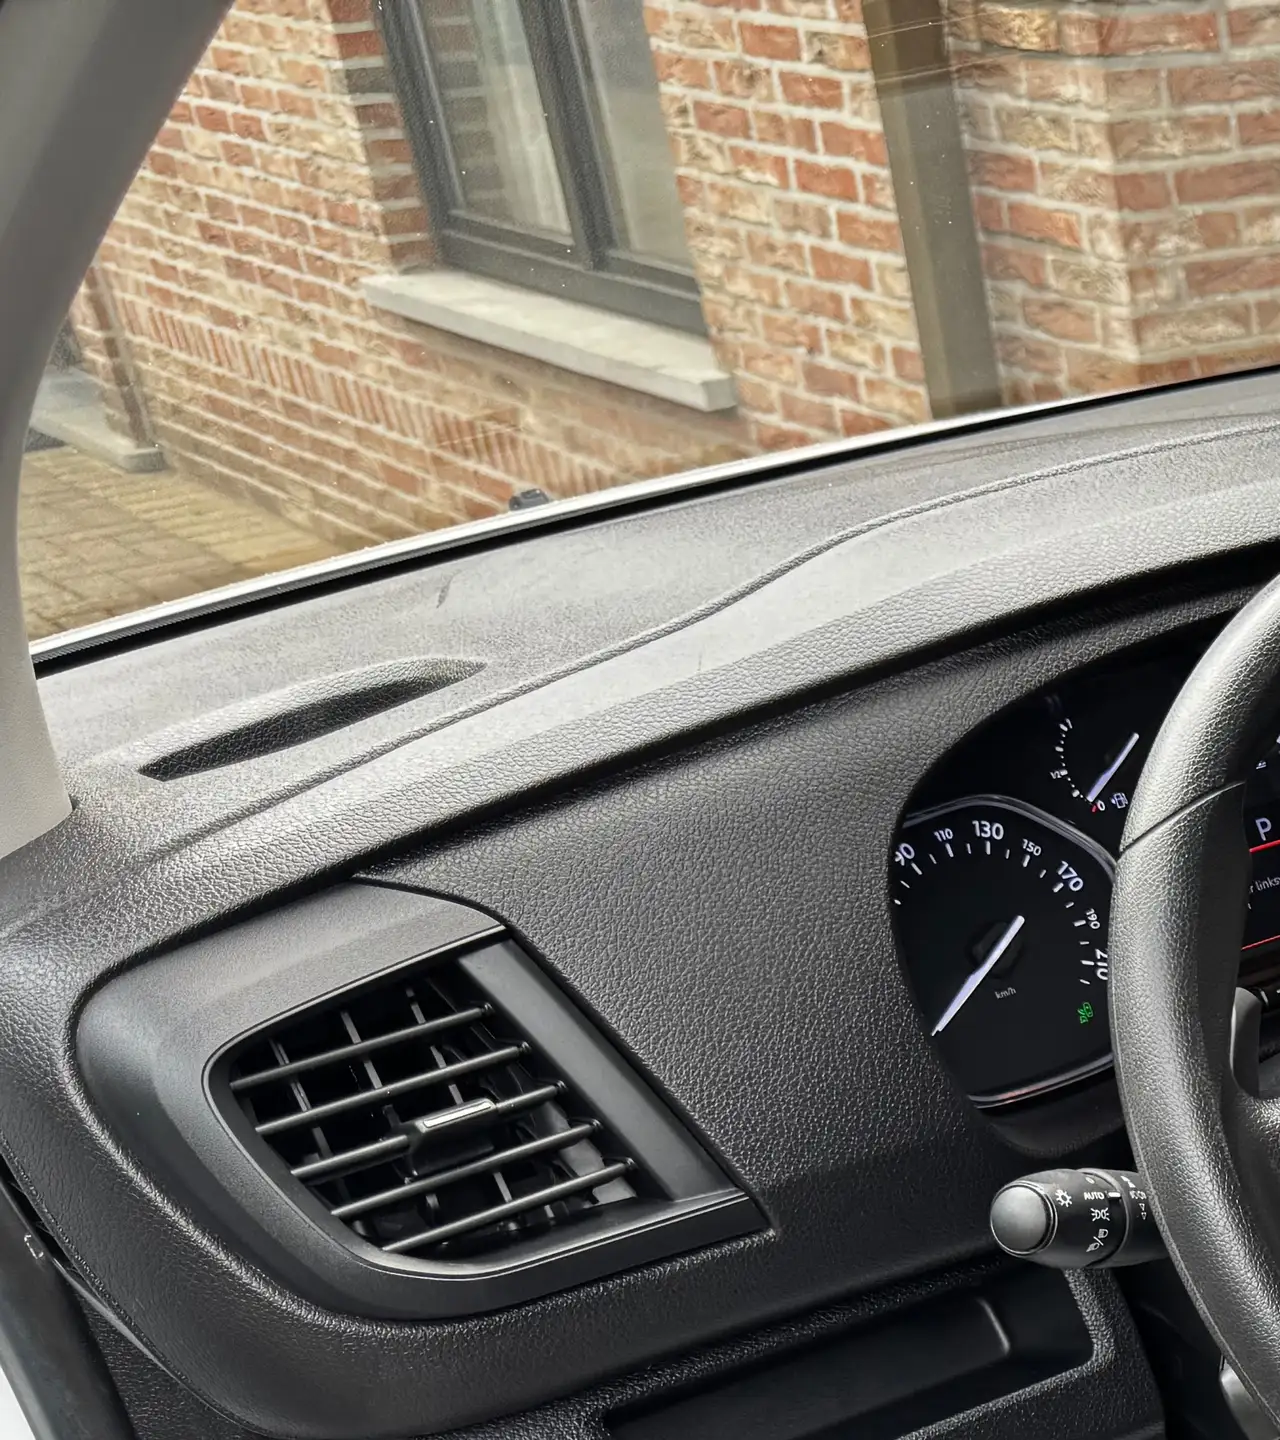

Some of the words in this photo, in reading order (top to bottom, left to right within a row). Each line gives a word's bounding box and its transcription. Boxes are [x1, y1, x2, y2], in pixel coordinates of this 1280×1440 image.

[934, 827, 954, 843] 110
[971, 819, 1005, 841] 130
[1021, 838, 1042, 858] 150
[1057, 860, 1084, 892] 170
[1085, 908, 1101, 930] 190
[994, 986, 1017, 999] km/h
[1083, 1191, 1105, 1200] AUTO
